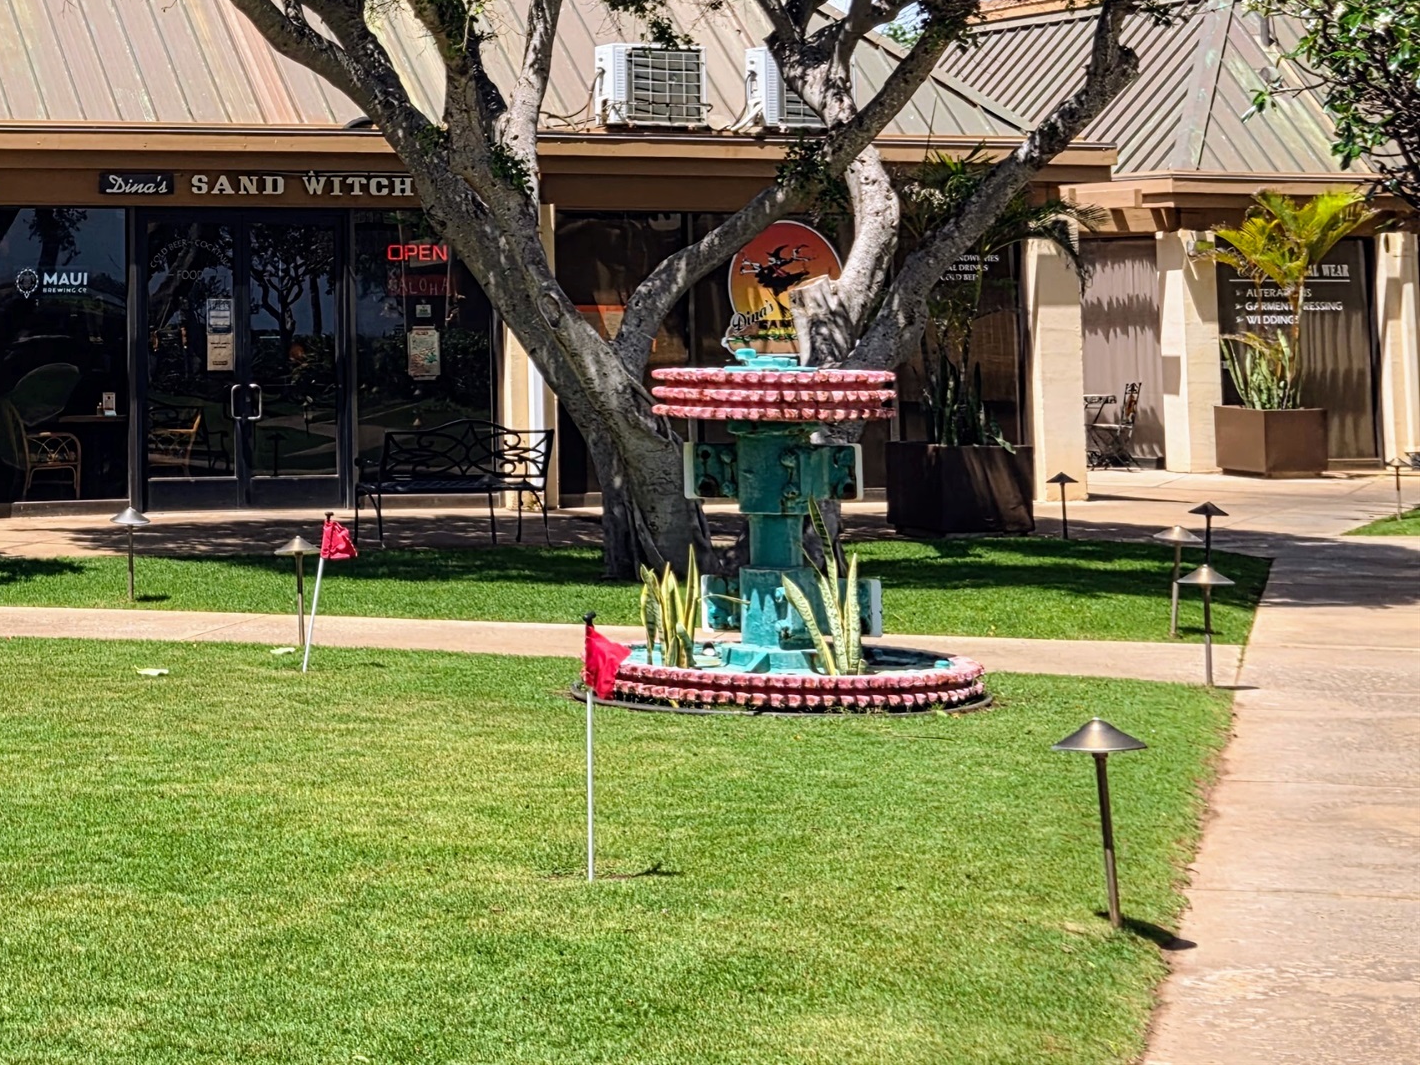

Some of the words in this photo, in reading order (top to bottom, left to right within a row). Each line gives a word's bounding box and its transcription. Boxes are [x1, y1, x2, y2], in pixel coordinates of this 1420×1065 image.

[106, 174, 168, 194] Dina's
[191, 174, 285, 195] SAND
[302, 175, 415, 196] WITCH
[387, 244, 448, 262] OPEN
[177, 269, 203, 281] FOOD
[1321, 264, 1350, 277] WEAR
[42, 272, 88, 286] MAUI
[397, 276, 449, 296] ALOHA
[1302, 301, 1343, 311] RESSING
